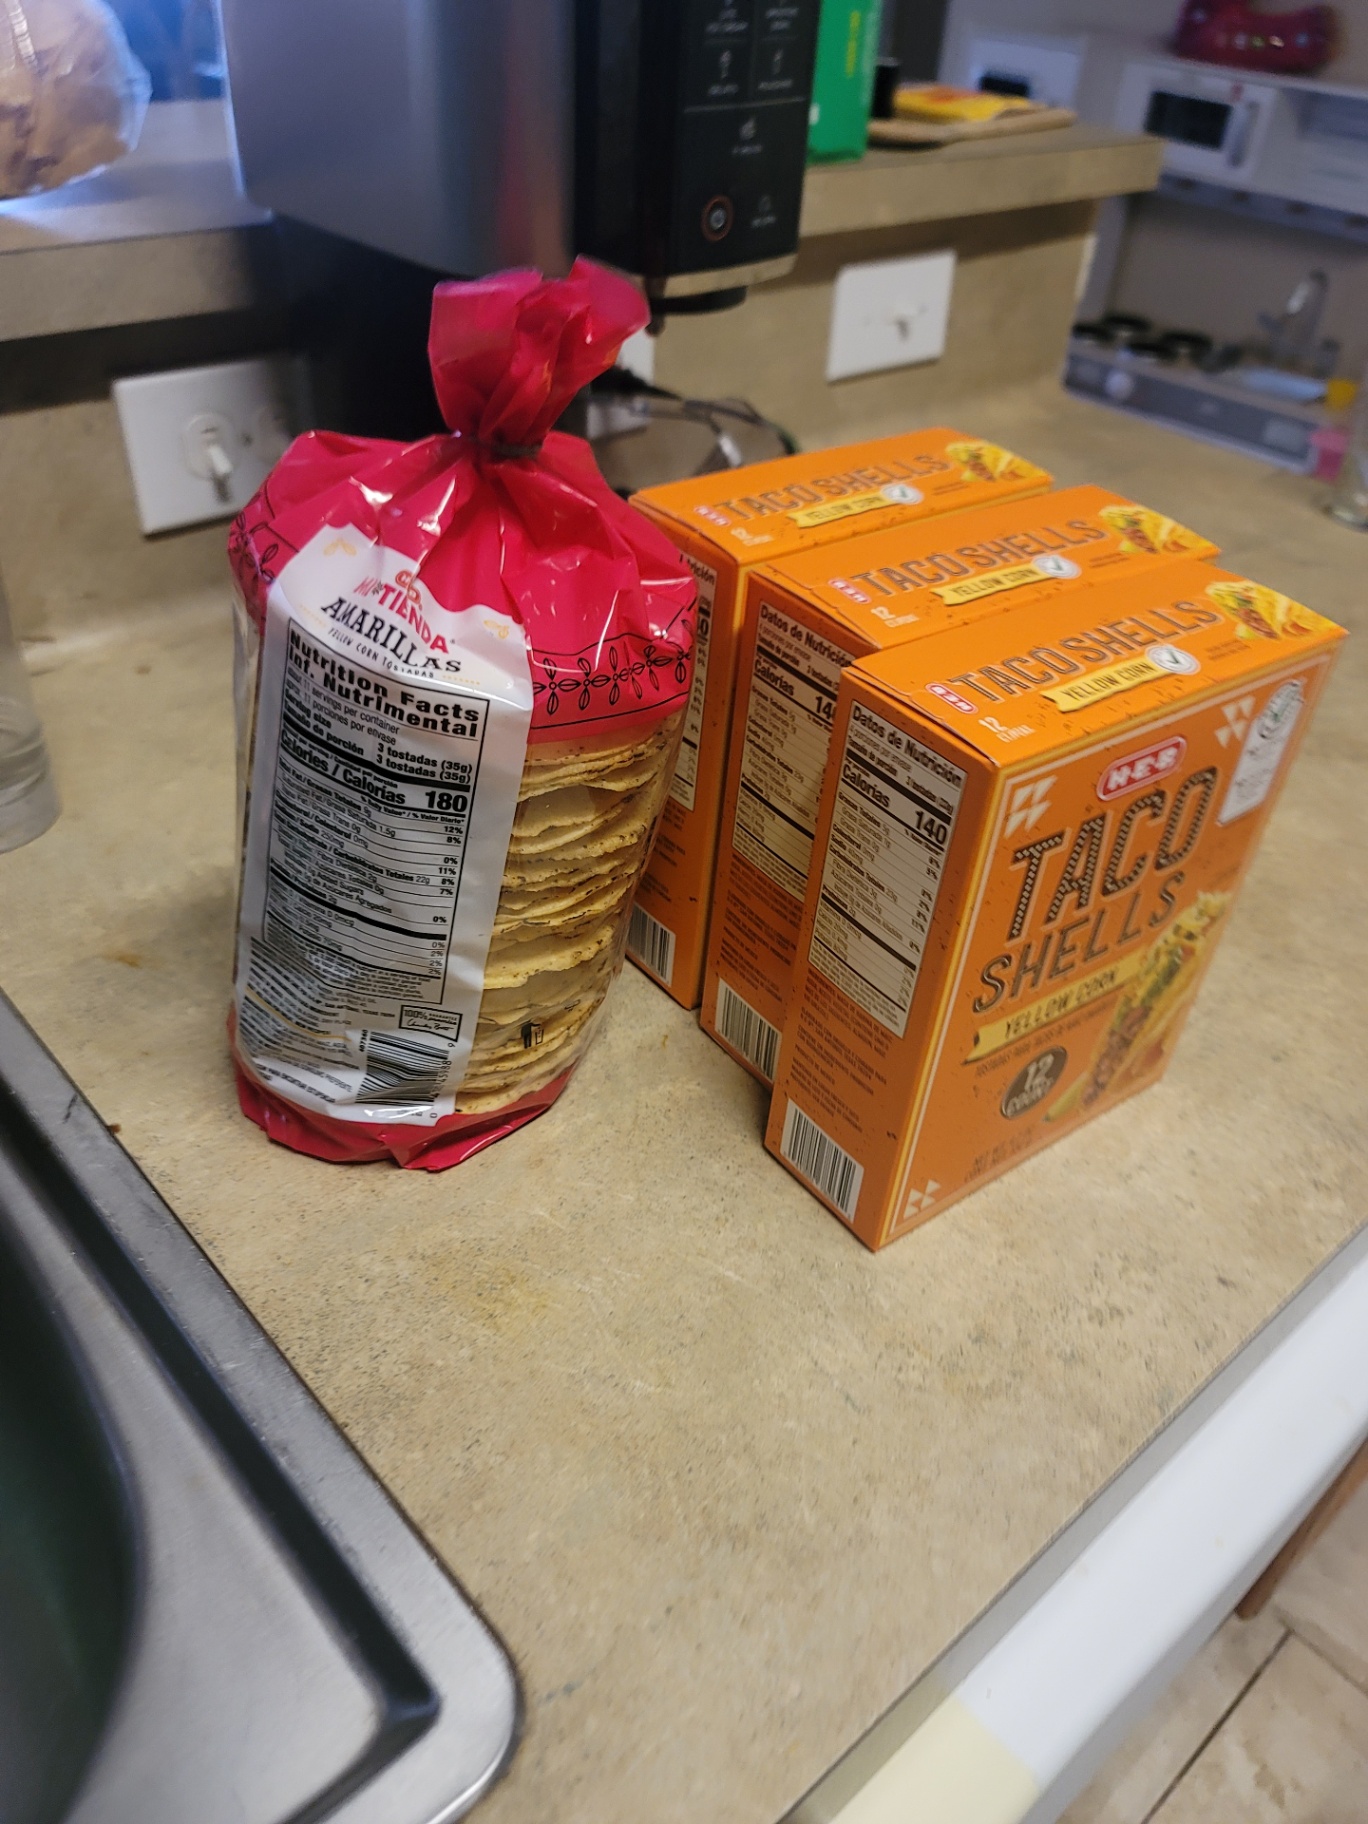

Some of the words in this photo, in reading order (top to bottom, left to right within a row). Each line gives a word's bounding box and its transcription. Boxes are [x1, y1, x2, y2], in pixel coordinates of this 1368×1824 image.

[713, 483, 827, 521] TACO
[808, 453, 954, 497] SHELLS
[803, 503, 855, 520] YELLOW
[850, 552, 974, 597] TACO
[950, 517, 1110, 569] SHELLS
[948, 576, 1006, 597] YELLOW
[1000, 567, 1041, 582] CORN
[321, 597, 461, 672] AMARILLAS
[378, 583, 449, 654] TIENDA
[760, 602, 789, 633] Datos
[789, 622, 803, 642] de
[356, 643, 379, 661] CORN
[946, 645, 1085, 704] TACO
[1055, 598, 1225, 665] SHELLS
[289, 627, 389, 701] Nutrition
[399, 690, 480, 723] Facts
[289, 644, 315, 678] Inf.
[323, 667, 479, 737] Nutrimental
[1060, 674, 1126, 702] YELLOW
[1113, 661, 1160, 682] CORN
[311, 684, 342, 711] servings
[343, 702, 357, 720] per
[359, 709, 400, 736] container
[312, 697, 348, 727] porciones
[350, 717, 364, 734] por
[366, 725, 396, 747] envase
[313, 709, 331, 729] size
[815, 696, 836, 722] 14
[977, 717, 1008, 734] 12
[312, 721, 324, 736] de
[326, 728, 364, 758] porción
[852, 704, 887, 739] Datos
[886, 727, 903, 750] de
[903, 737, 963, 789] Nutrición
[375, 752, 383, 764] 3
[386, 756, 436, 778] tostadas
[438, 770, 471, 784] (35g)
[377, 741, 384, 753] 3
[387, 745, 438, 767] tostadas
[440, 759, 473, 775] (35g)
[332, 761, 339, 777] /
[341, 766, 406, 807] Calorías
[423, 789, 468, 813] 180
[331, 812, 350, 828] Trans
[419, 813, 439, 821] Valor
[842, 762, 891, 808] Calorías
[912, 807, 948, 847] 140
[378, 824, 396, 838] 1.5g
[443, 825, 463, 834] 12%
[446, 835, 462, 844] 8%
[443, 856, 458, 865] 0%
[1008, 766, 1217, 940] TACO
[415, 874, 431, 885] 22g
[437, 866, 457, 875] 11%
[438, 888, 454, 896] 7%
[432, 915, 447, 923] 0%
[973, 871, 1185, 1013] SHELLS
[429, 959, 443, 967] 2%
[404, 1009, 428, 1020] 100%
[1005, 991, 1072, 1038] YELLOW
